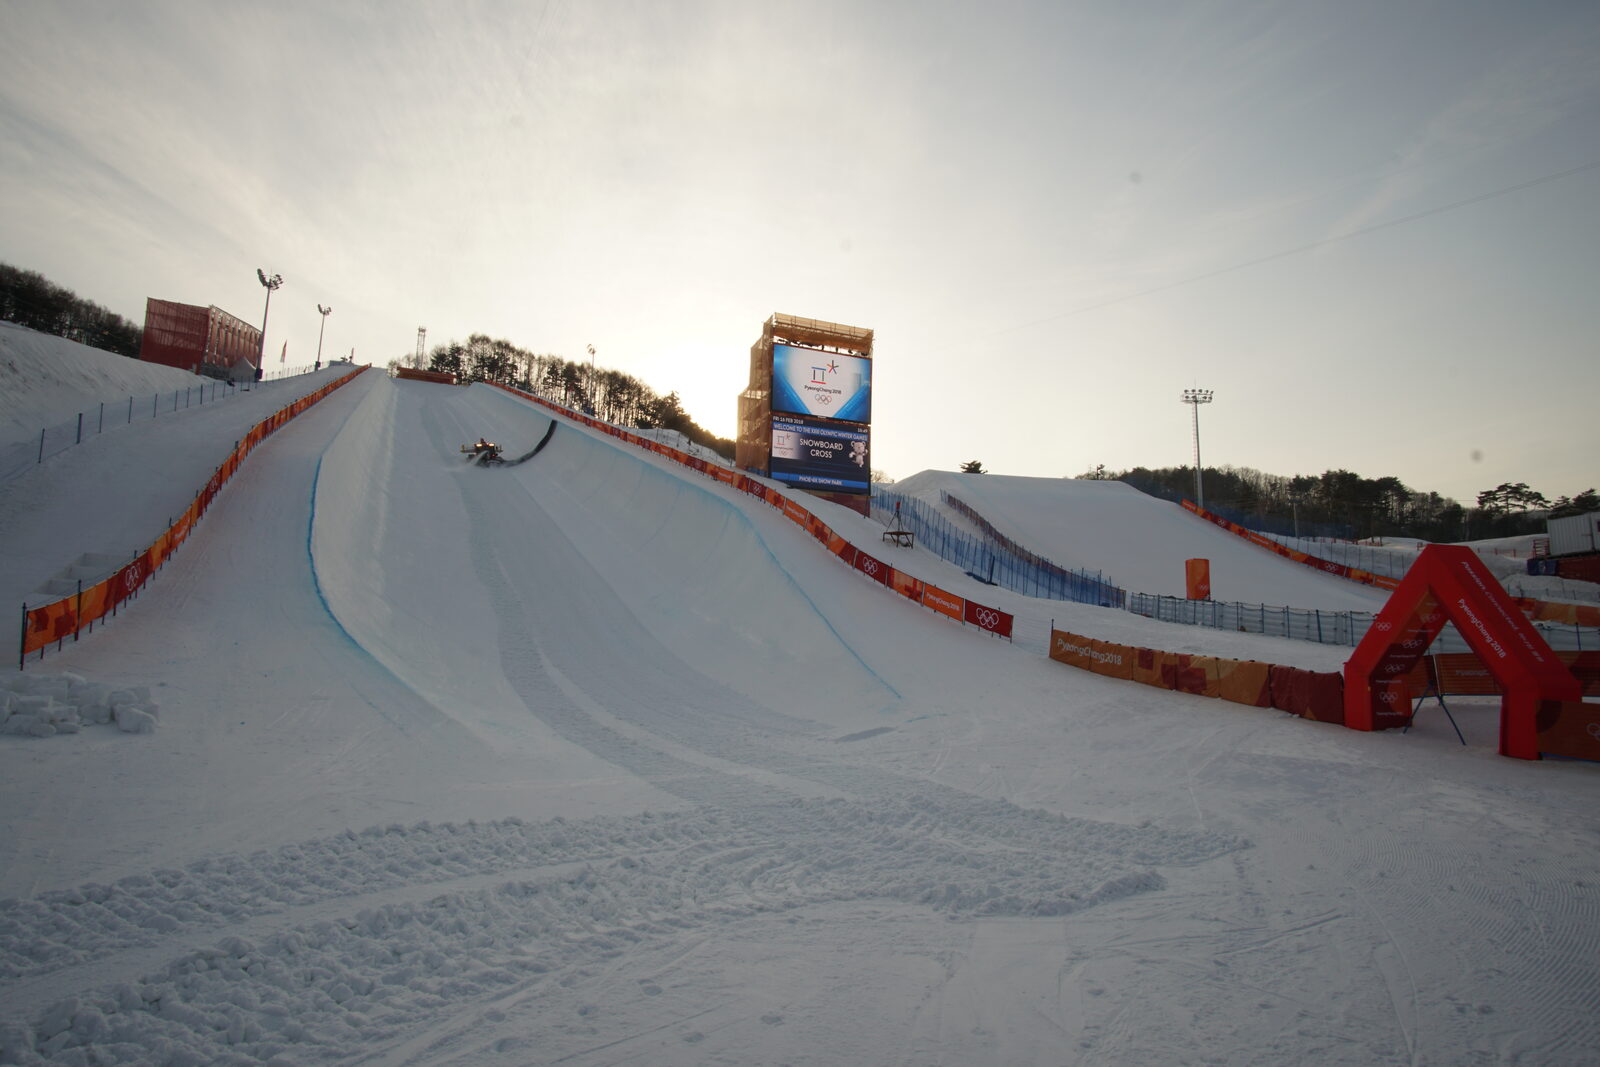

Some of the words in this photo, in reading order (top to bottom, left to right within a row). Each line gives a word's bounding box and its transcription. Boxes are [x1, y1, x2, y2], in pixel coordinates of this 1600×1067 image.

[820, 428, 838, 437] OLYMPIC
[838, 431, 853, 439] WINTER
[799, 438, 843, 451] SNOWBOARD
[810, 449, 832, 459] CROSS
[1458, 598, 1493, 644] PyeongChang
[1491, 640, 1507, 658] 2018
